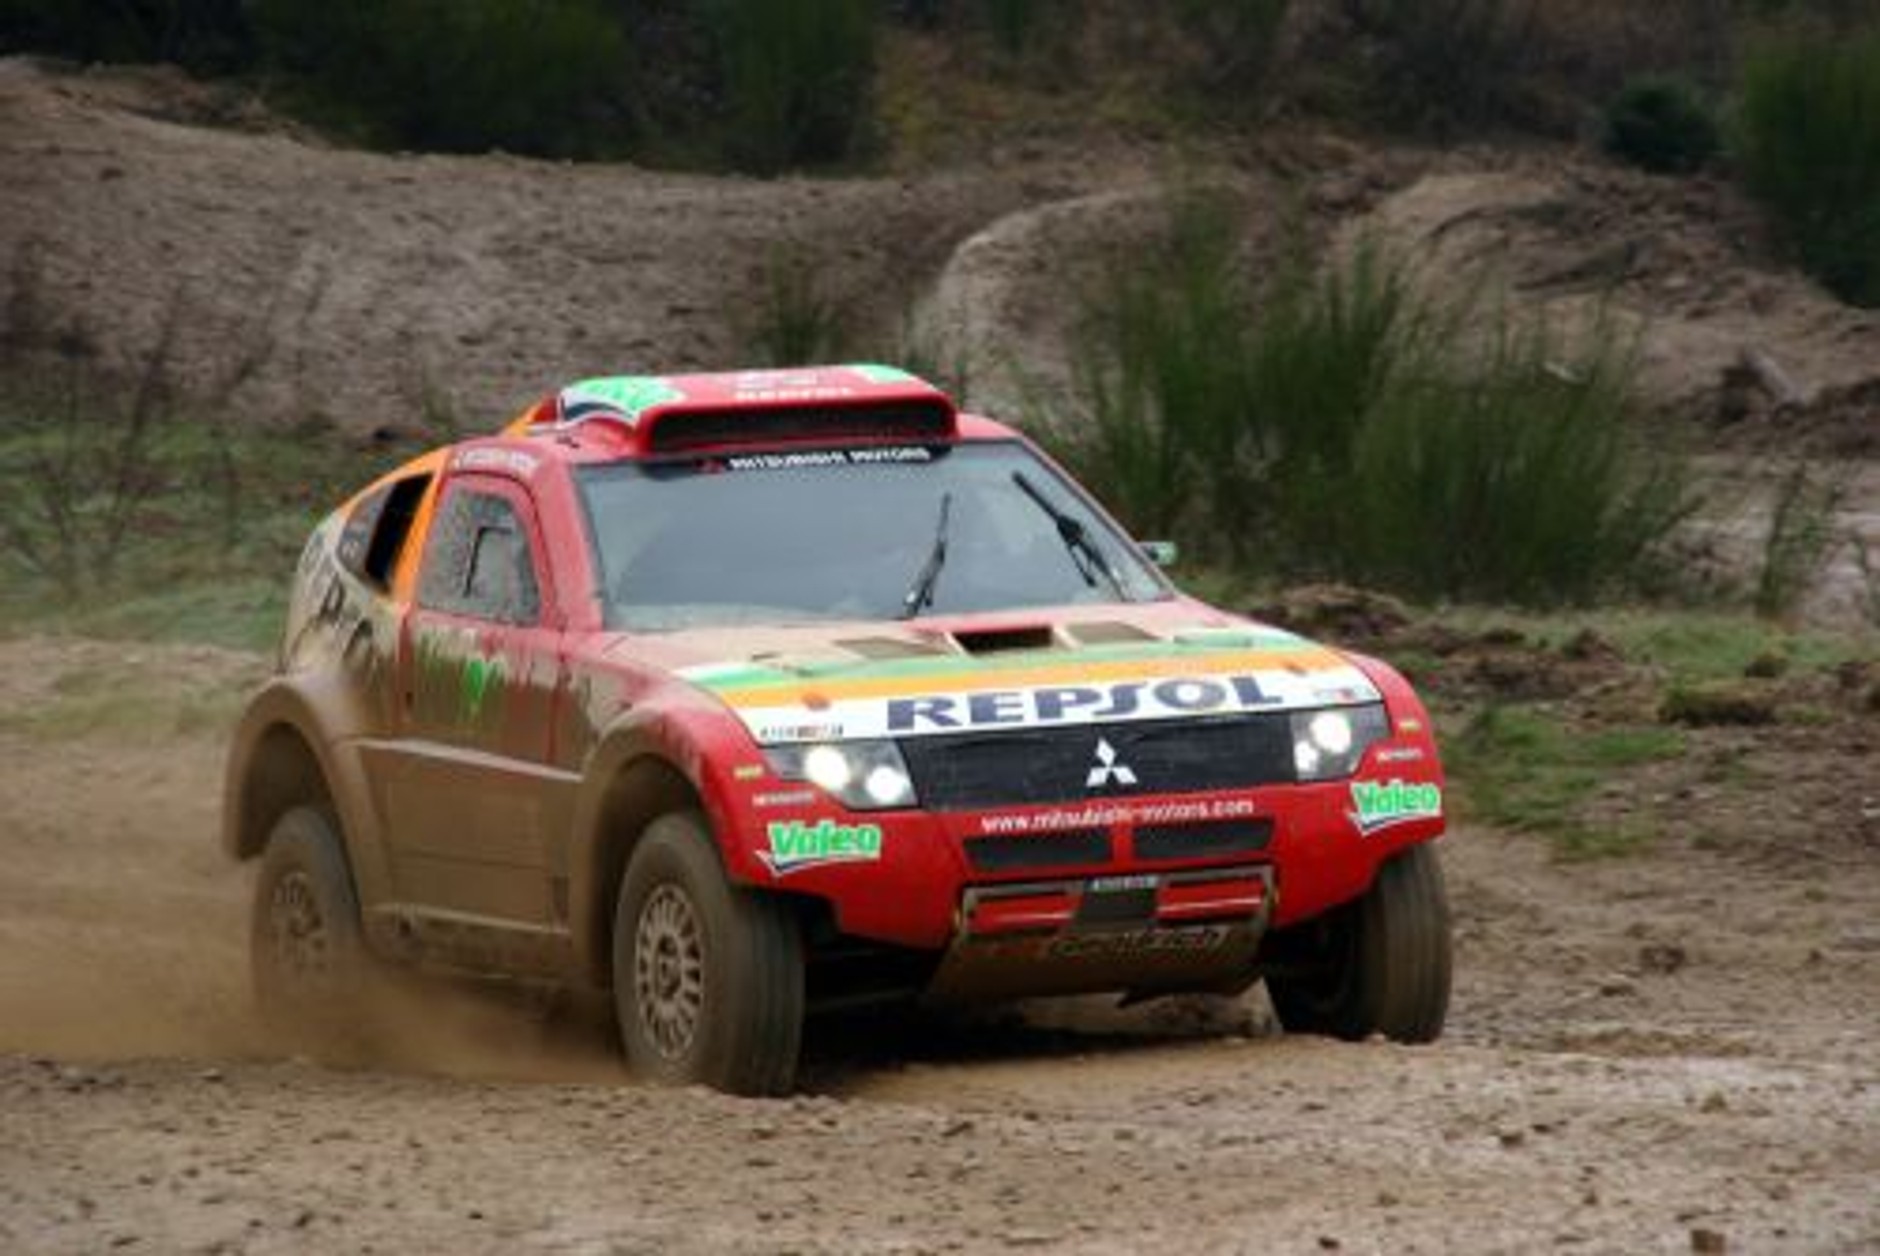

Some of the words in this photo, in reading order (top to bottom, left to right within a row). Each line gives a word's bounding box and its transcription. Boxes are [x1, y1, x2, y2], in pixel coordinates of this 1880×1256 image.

[886, 675, 1283, 732] REPSOL
[1350, 779, 1441, 817] Valeo
[767, 819, 883, 860] Valeo
